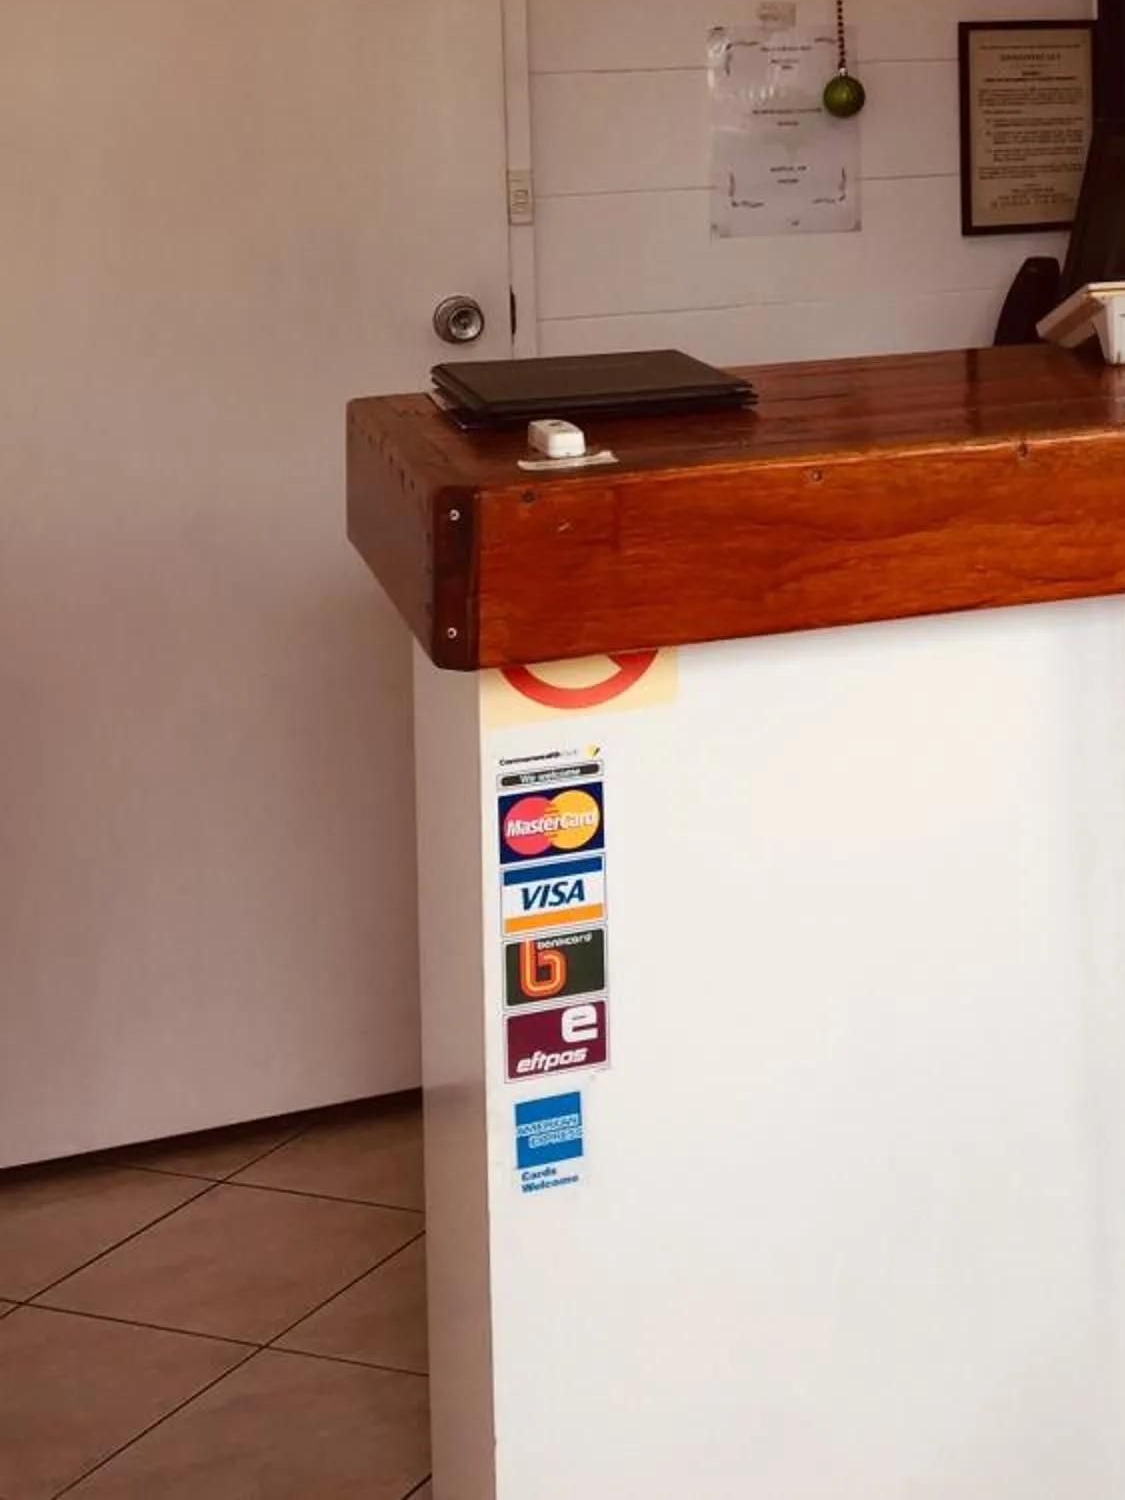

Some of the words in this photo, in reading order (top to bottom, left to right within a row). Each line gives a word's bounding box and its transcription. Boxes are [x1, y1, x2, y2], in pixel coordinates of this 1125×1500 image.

[507, 810, 596, 837] MasterCard
[520, 879, 585, 911] VISA
[562, 1003, 598, 1043] e
[516, 1046, 589, 1074] eftpos
[522, 1166, 557, 1181] Cards
[522, 1175, 579, 1193] Welcome
